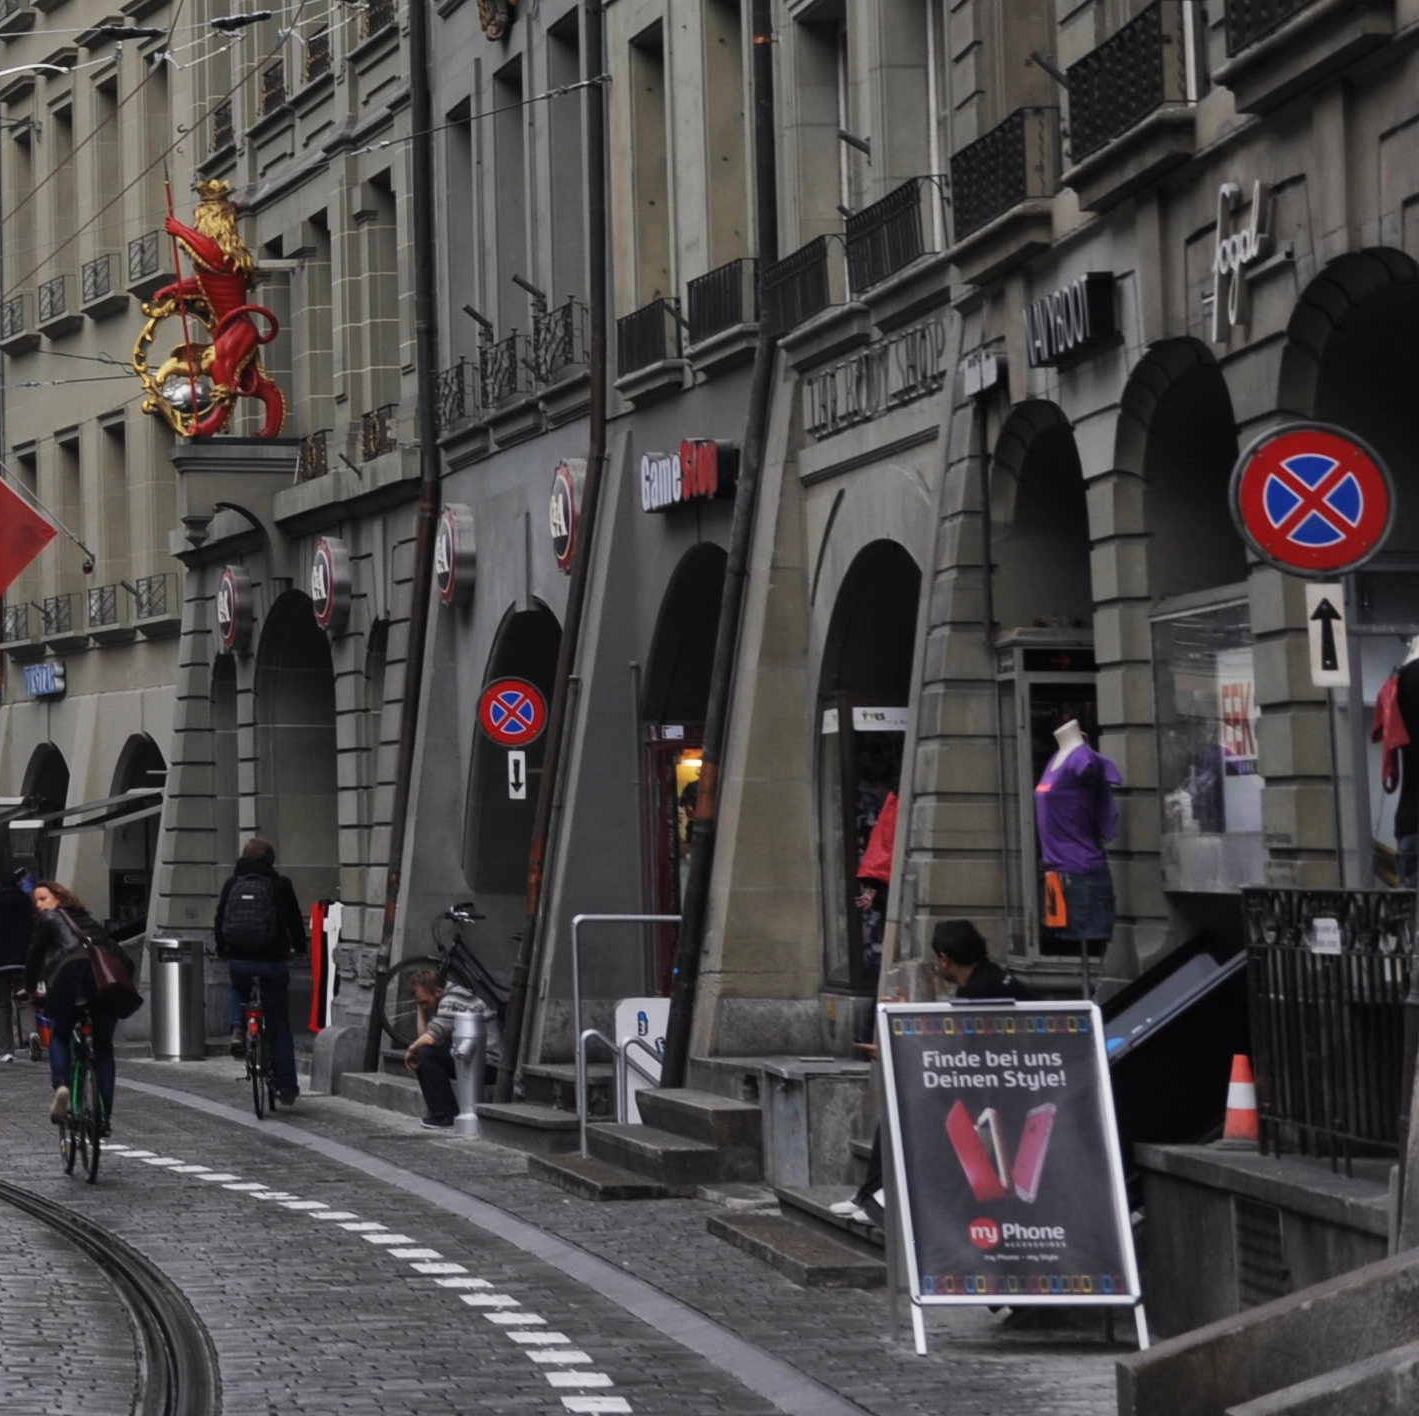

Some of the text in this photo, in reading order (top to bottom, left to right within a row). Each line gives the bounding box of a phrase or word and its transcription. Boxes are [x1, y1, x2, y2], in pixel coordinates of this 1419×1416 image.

[1211, 179, 1260, 344] fogal
[1023, 273, 1091, 366] NAVYBOOT
[922, 1050, 1063, 1067] Finde bei uns
[922, 1070, 1067, 1091] Deinen Style!
[970, 1222, 1066, 1243] my Phone
